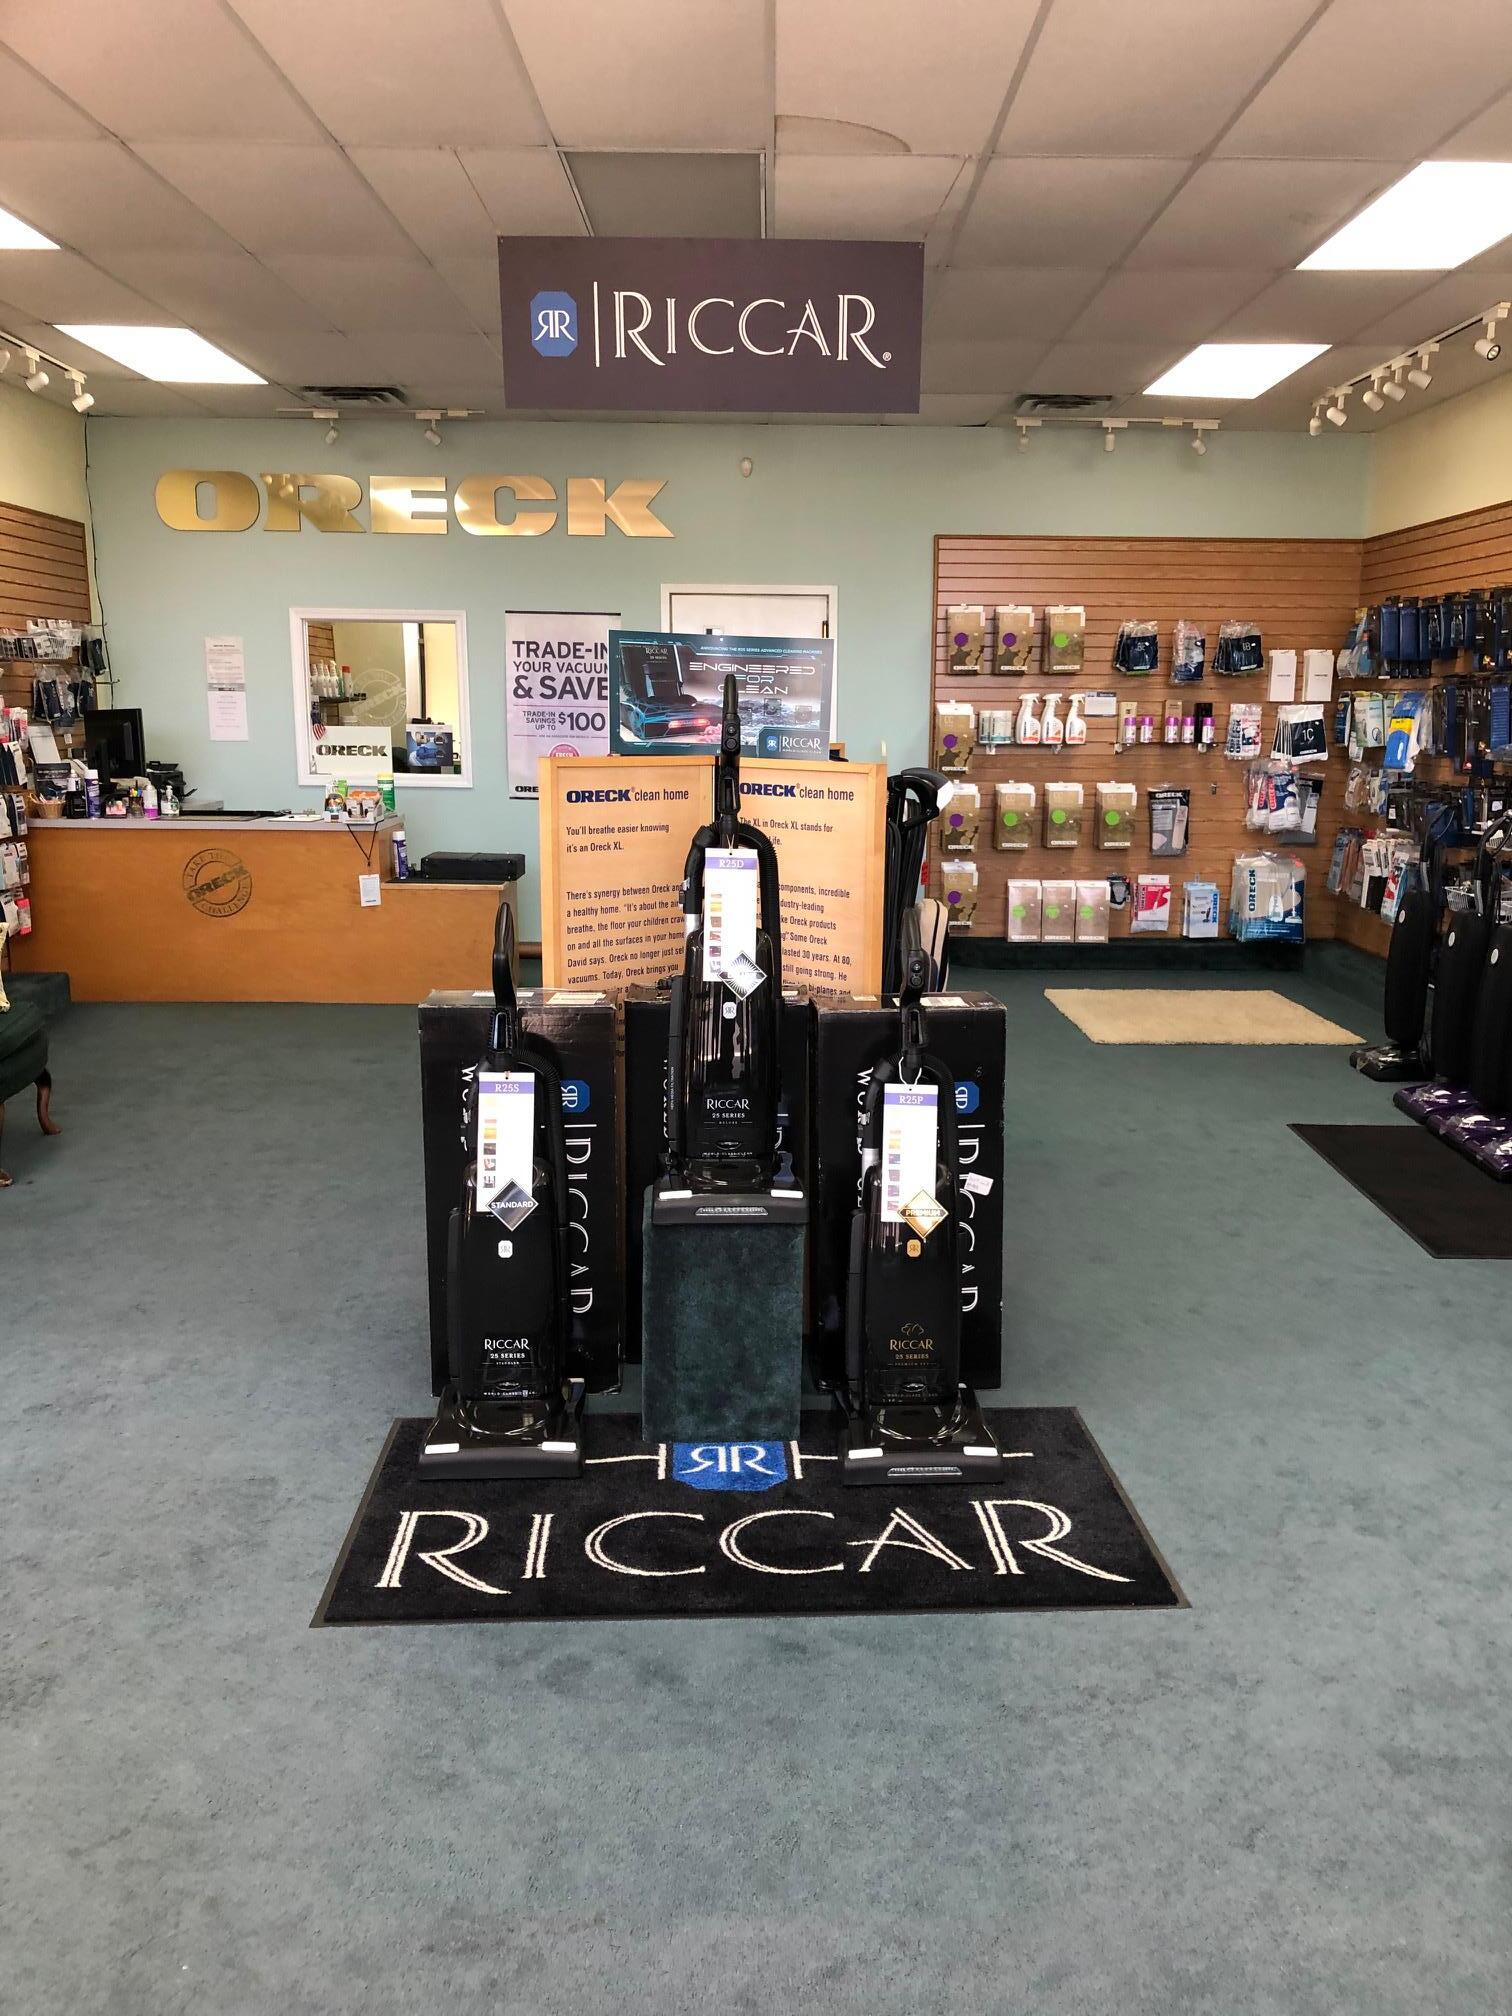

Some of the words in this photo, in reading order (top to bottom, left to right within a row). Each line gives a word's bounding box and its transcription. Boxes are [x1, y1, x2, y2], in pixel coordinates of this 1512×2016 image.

[613, 291, 886, 369] RICCAR
[154, 470, 675, 538] ORECK
[514, 662, 551, 673] YOUR
[689, 662, 815, 674] ENGINEERED
[513, 676, 531, 699] &
[540, 676, 608, 700] SAVE
[559, 713, 605, 731] $100
[783, 736, 821, 750] RICCAR
[316, 745, 387, 756] ORECK
[566, 789, 632, 803] ORECK
[635, 789, 660, 800] clean
[663, 789, 689, 800] home
[740, 783, 796, 798] ORECK
[800, 786, 824, 799] clean
[828, 786, 854, 801] home
[566, 826, 586, 836] You'll
[588, 825, 615, 834] breathe
[618, 824, 638, 833] easier
[641, 823, 669, 833] knowing
[753, 818, 761, 827] XL
[770, 820, 789, 829] Oreck
[790, 821, 799, 831] XL
[800, 823, 822, 832] stands
[824, 823, 833, 833] for
[566, 843, 577, 853] it's
[580, 844, 588, 852] an
[590, 842, 611, 851] Oreck
[613, 841, 624, 850] XL.
[719, 860, 744, 868] R25D
[567, 891, 592, 900] There's
[594, 889, 620, 899] synergy
[623, 887, 650, 895] between
[652, 884, 670, 893] Oreck
[819, 888, 850, 898] incredible
[573, 906, 598, 917] healthy
[601, 905, 621, 913] home.
[639, 902, 657, 910] about
[659, 900, 668, 908] the
[780, 902, 824, 913] dustry-leading
[567, 924, 595, 934] breathe,
[610, 921, 625, 929] floor
[628, 920, 641, 929] your
[643, 916, 669, 926] children
[790, 916, 807, 926] Oreck
[809, 920, 836, 930] products
[567, 943, 575, 951] on
[578, 940, 590, 949] and
[592, 939, 601, 948] all
[603, 938, 613, 946] the
[615, 935, 643, 945] surfaces
[653, 933, 666, 943] your
[790, 932, 808, 942] Some
[809, 935, 827, 945] Oreck
[568, 957, 587, 967] David
[589, 957, 604, 965] says.
[609, 953, 628, 962] Oreck
[640, 950, 660, 959] longer
[662, 948, 673, 958] just
[782, 948, 801, 958] lasted
[802, 950, 810, 959] 30
[833, 954, 840, 962] At
[568, 974, 600, 984] vacuums.
[603, 971, 624, 979] Today,
[626, 968, 644, 976] Oreck
[646, 965, 666, 975] brings
[667, 964, 679, 972] you
[783, 964, 794, 972] still
[796, 966, 812, 977] going
[814, 968, 836, 981] strong.
[839, 972, 847, 981] He
[495, 1083, 520, 1092] R25S
[706, 1099, 750, 1110] RICCAR
[899, 1096, 924, 1104] R25P
[490, 1201, 534, 1209] STANDARD
[484, 1338, 530, 1350] RICCAR
[890, 1339, 934, 1351] RICCAR
[375, 1498, 1137, 1595] RICCAR
